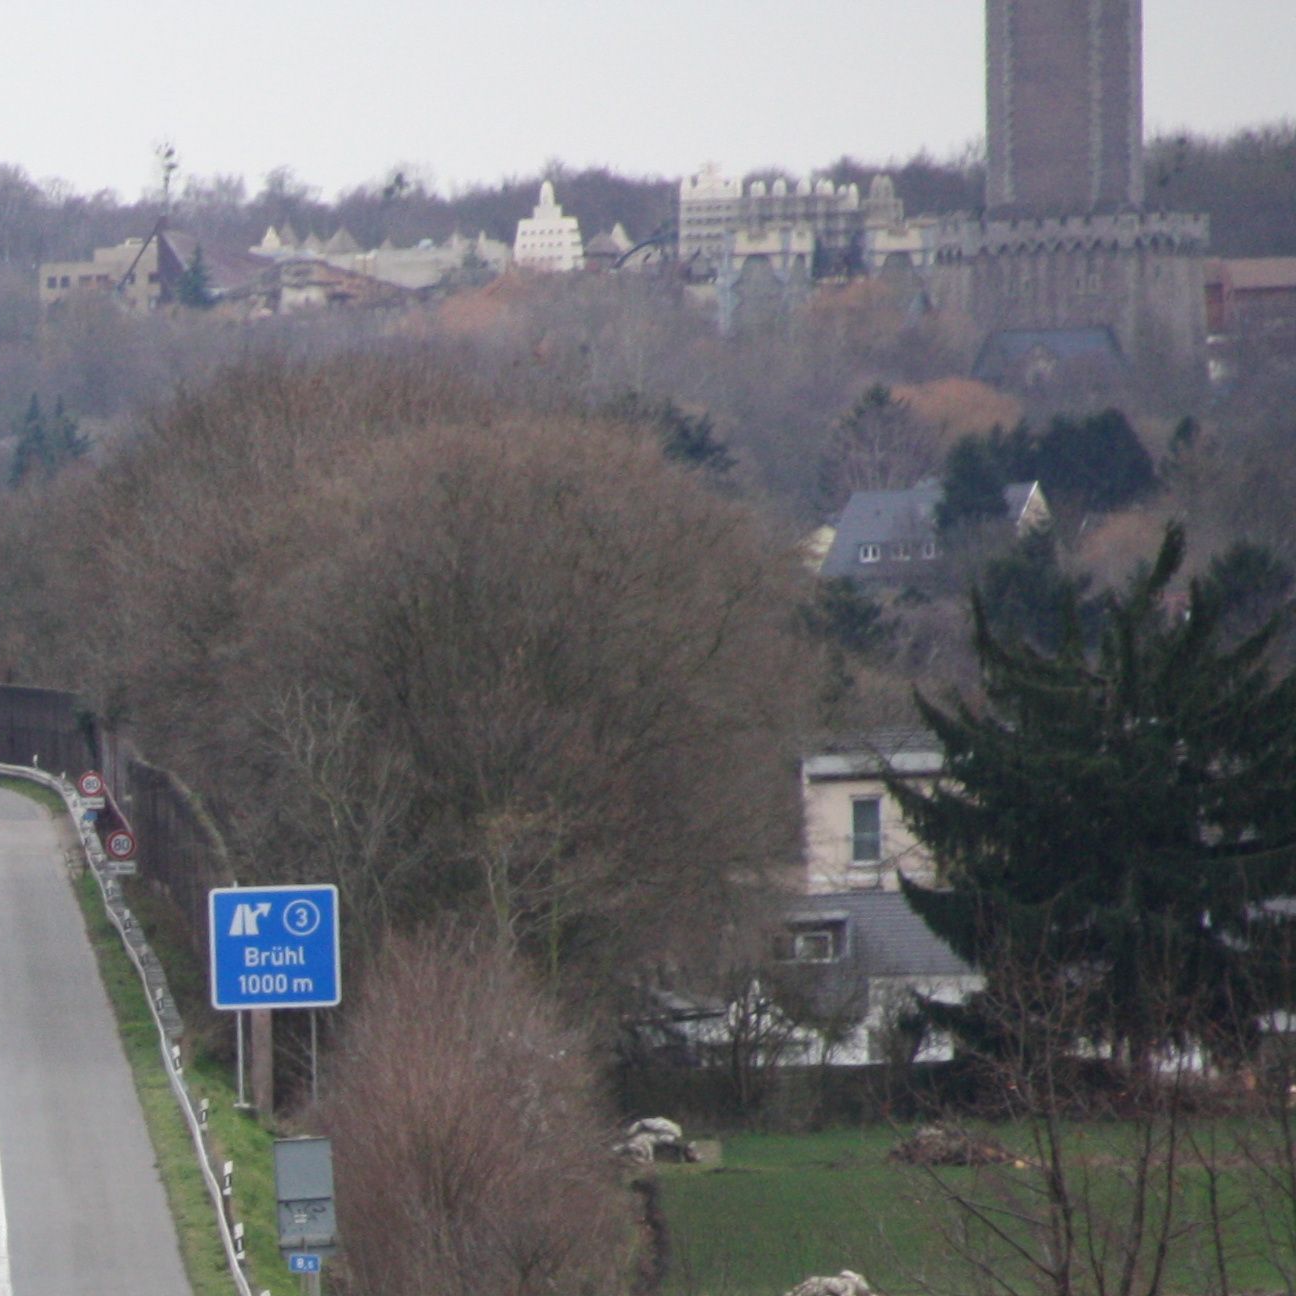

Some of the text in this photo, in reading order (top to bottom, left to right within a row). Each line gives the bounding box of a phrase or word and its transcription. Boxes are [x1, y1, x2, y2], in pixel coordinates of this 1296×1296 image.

[114, 838, 129, 851] 80
[295, 907, 308, 928] 3
[244, 946, 306, 967] Brühl
[238, 974, 314, 994] 1000 m
